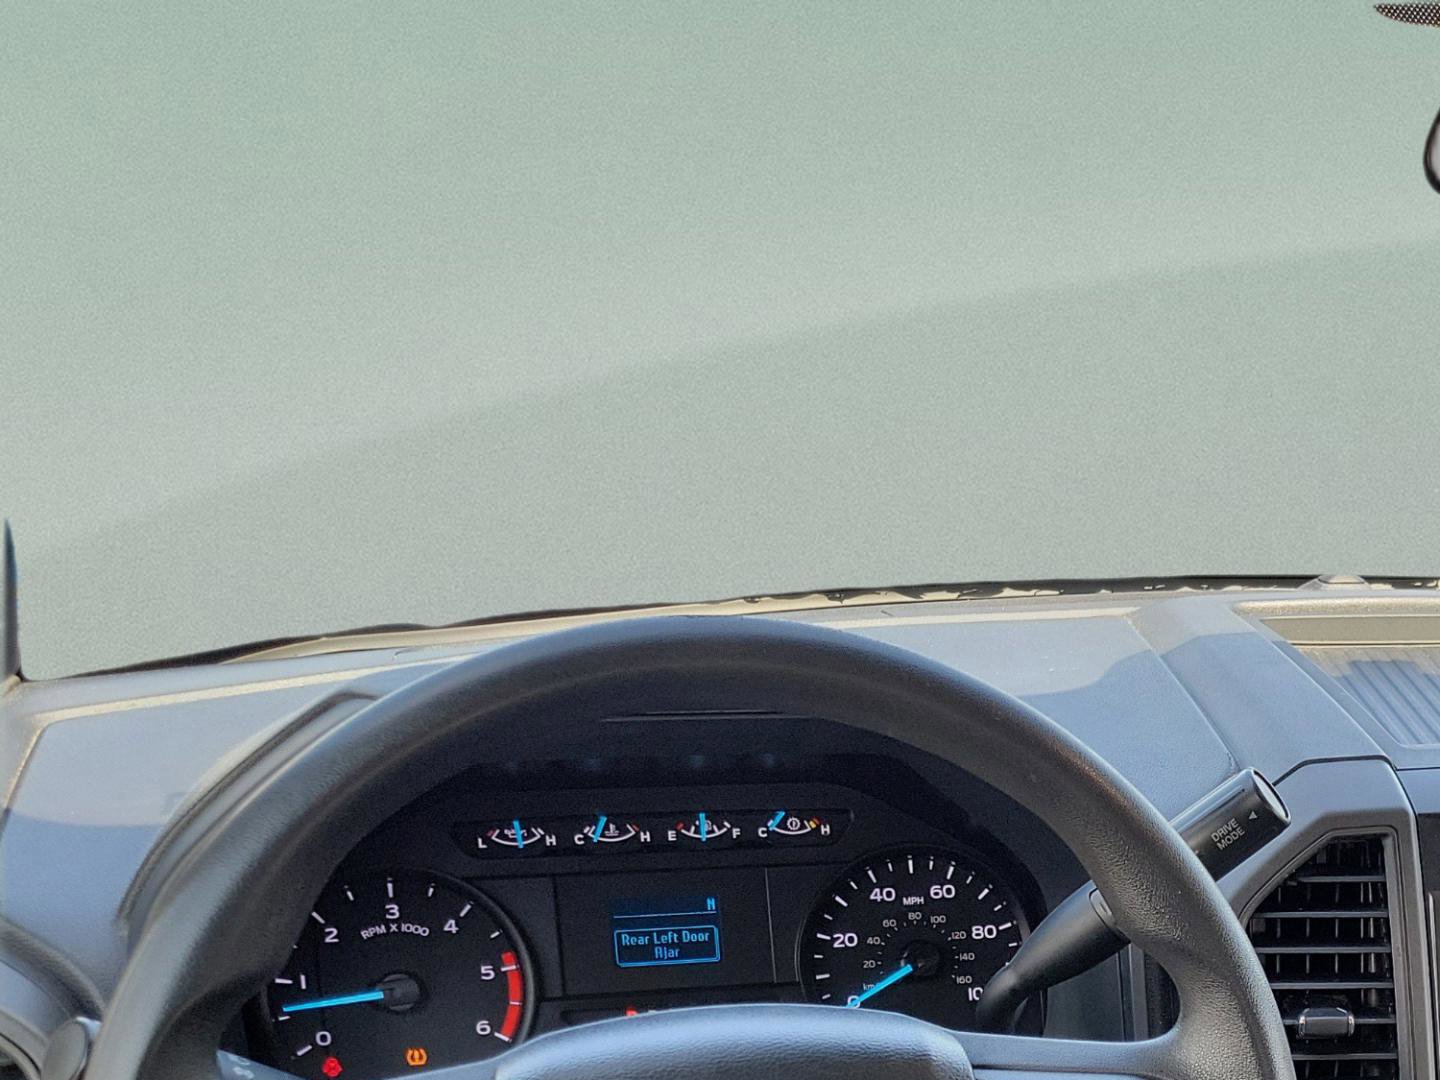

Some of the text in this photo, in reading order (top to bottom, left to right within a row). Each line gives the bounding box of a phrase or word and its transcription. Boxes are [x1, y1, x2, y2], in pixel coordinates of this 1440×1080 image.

[640, 831, 651, 842] H
[668, 831, 677, 841] E
[732, 828, 740, 838] F
[758, 827, 768, 837] C
[821, 825, 830, 835] H
[1210, 818, 1239, 842] DRIVE
[478, 838, 487, 848] L
[545, 835, 556, 846] H
[574, 834, 585, 845] C
[1217, 826, 1246, 851] MODE
[869, 888, 896, 902] 40
[930, 885, 955, 899] 60
[903, 896, 924, 905] MPH
[385, 904, 400, 919] 3
[908, 912, 922, 920] 80
[930, 915, 946, 923] 100
[361, 923, 429, 940] RPM X 1000
[443, 919, 459, 934] 4
[971, 925, 997, 939] 80
[324, 928, 339, 943] 2
[622, 930, 709, 946] Rear Left Door
[833, 933, 858, 948] 20
[952, 931, 966, 939] 120
[655, 946, 680, 960] Ajar
[959, 953, 975, 961] 140
[481, 966, 495, 980] 5
[956, 976, 972, 984] 160
[300, 975, 306, 989] 1
[476, 1020, 491, 1035] 6
[315, 1031, 332, 1046] 0
